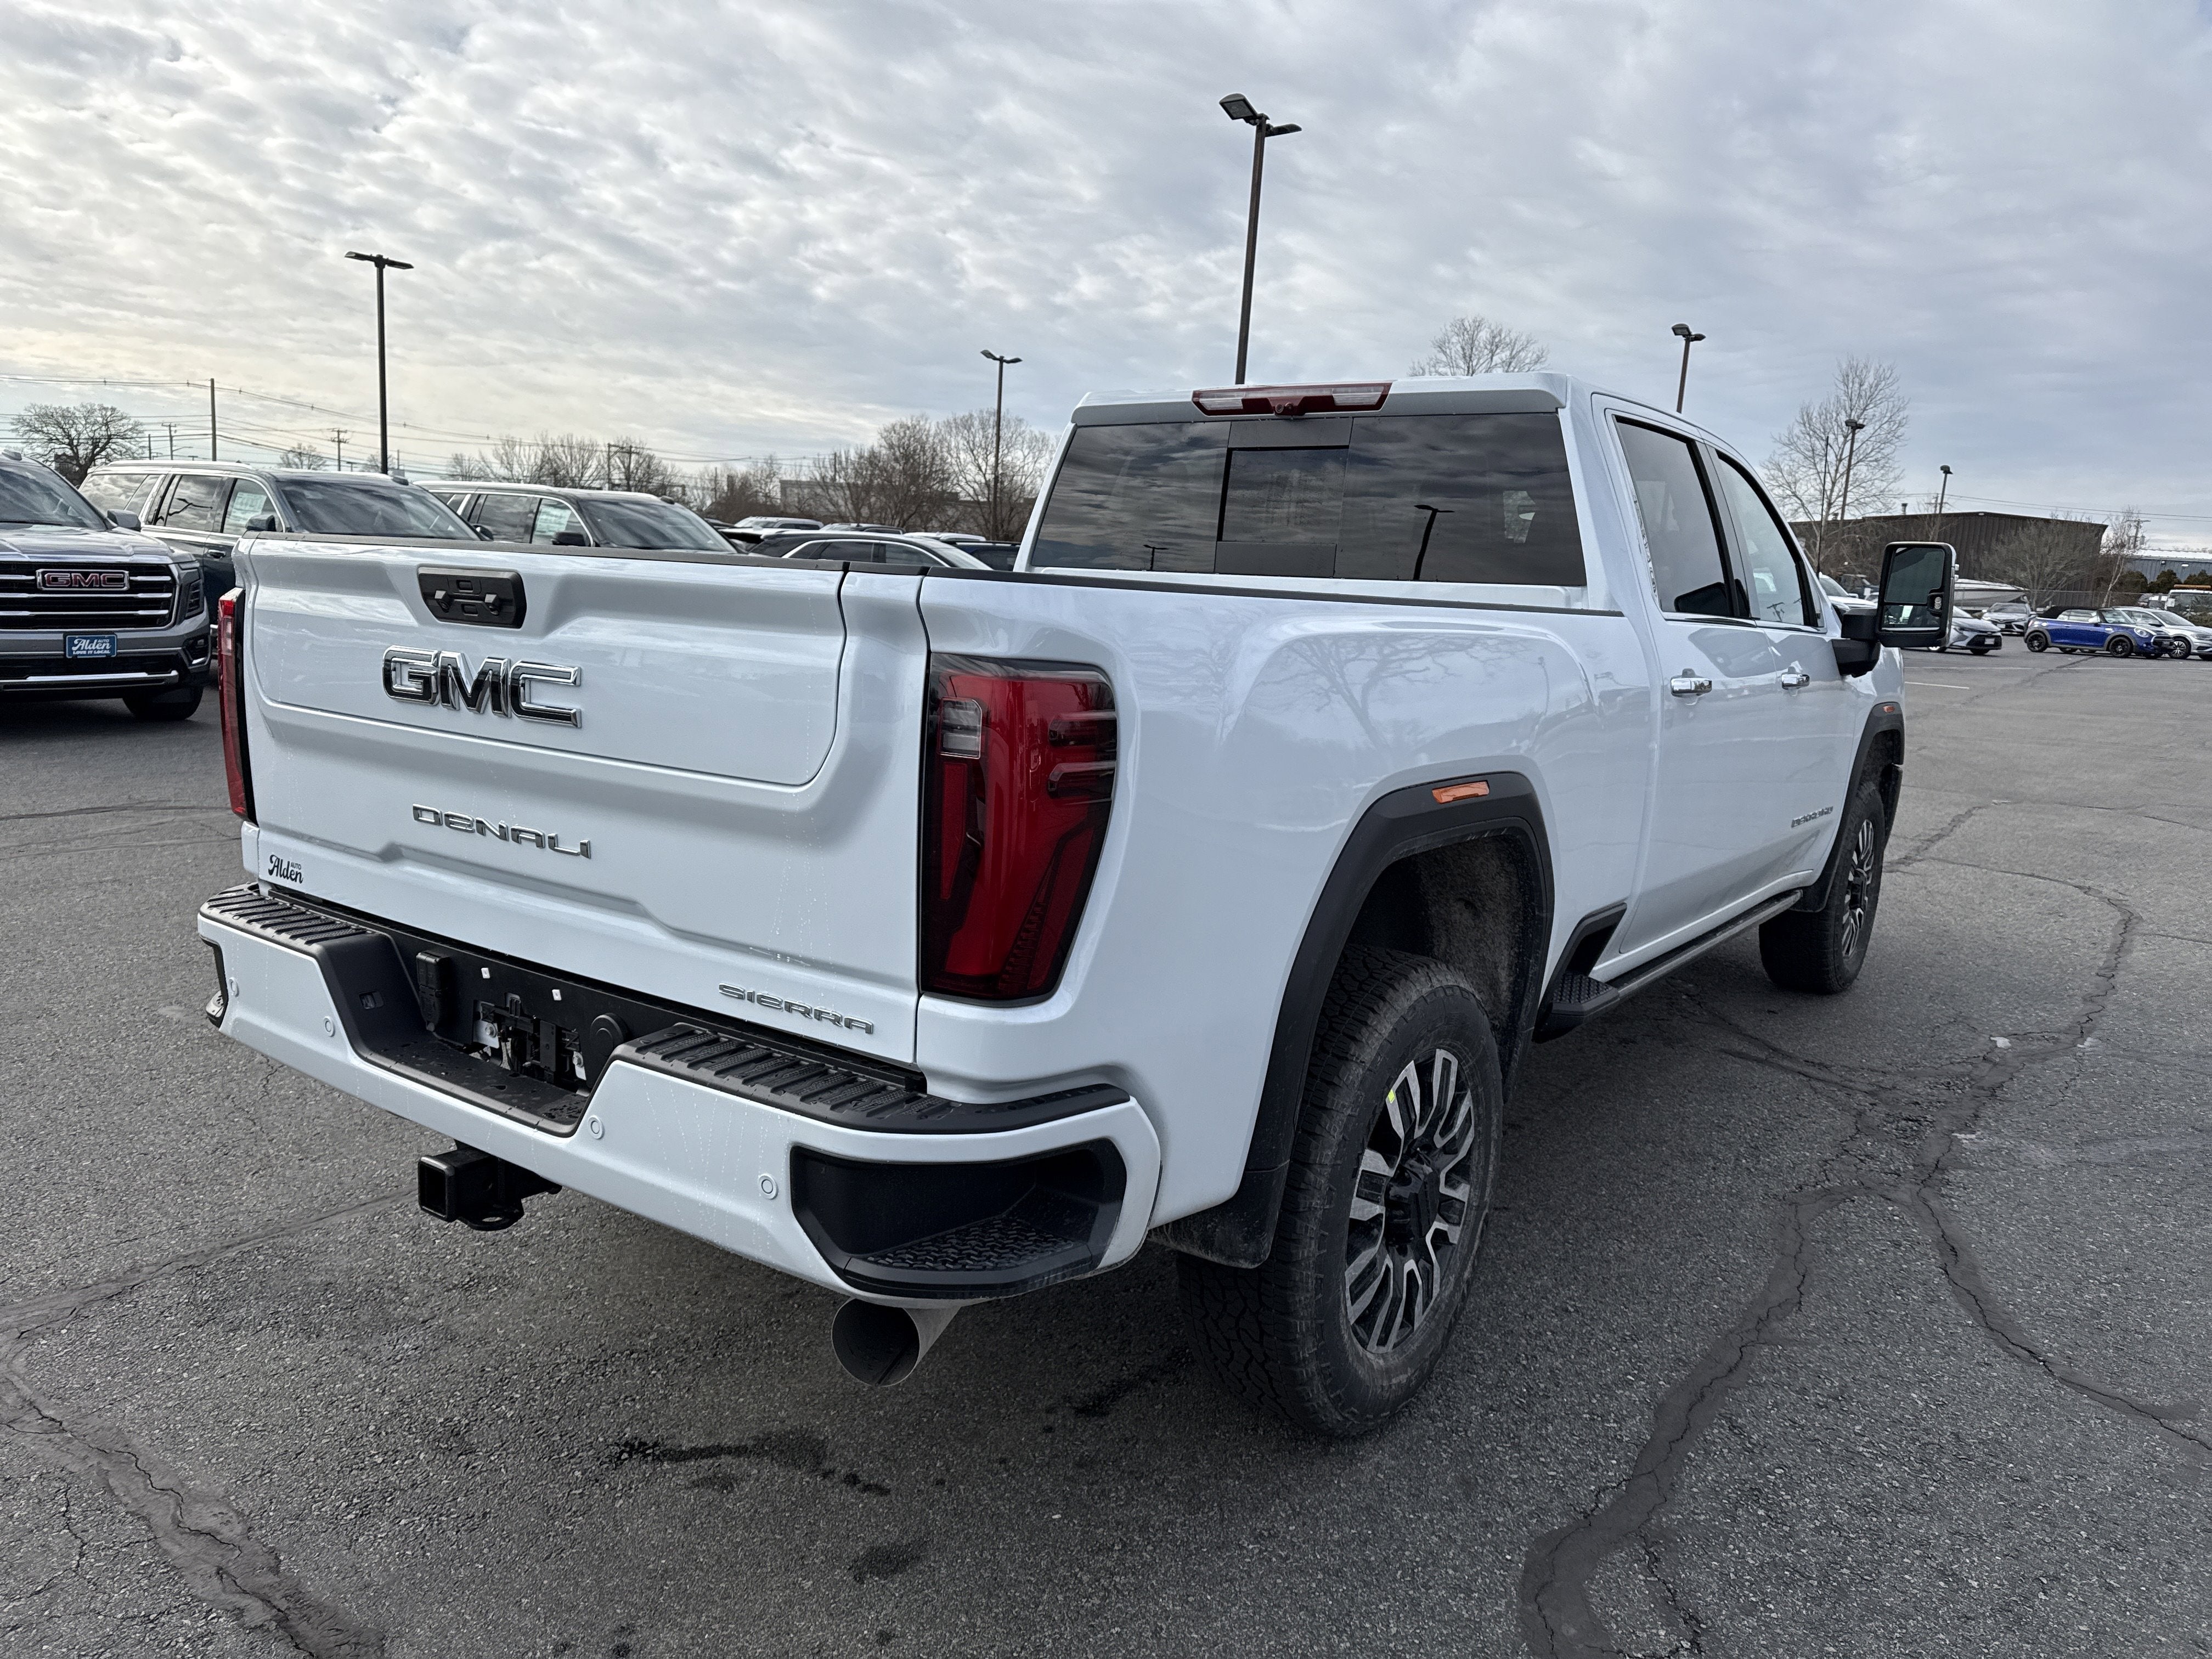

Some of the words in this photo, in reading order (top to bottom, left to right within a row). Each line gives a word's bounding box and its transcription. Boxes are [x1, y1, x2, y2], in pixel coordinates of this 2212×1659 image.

[44, 573, 125, 587] GMC
[71, 638, 112, 650] Alden
[382, 645, 582, 729] GMC
[413, 803, 591, 859] DENALI
[268, 854, 304, 884] Alden
[290, 862, 302, 870] AUTO
[718, 982, 874, 1035] SIERRA
